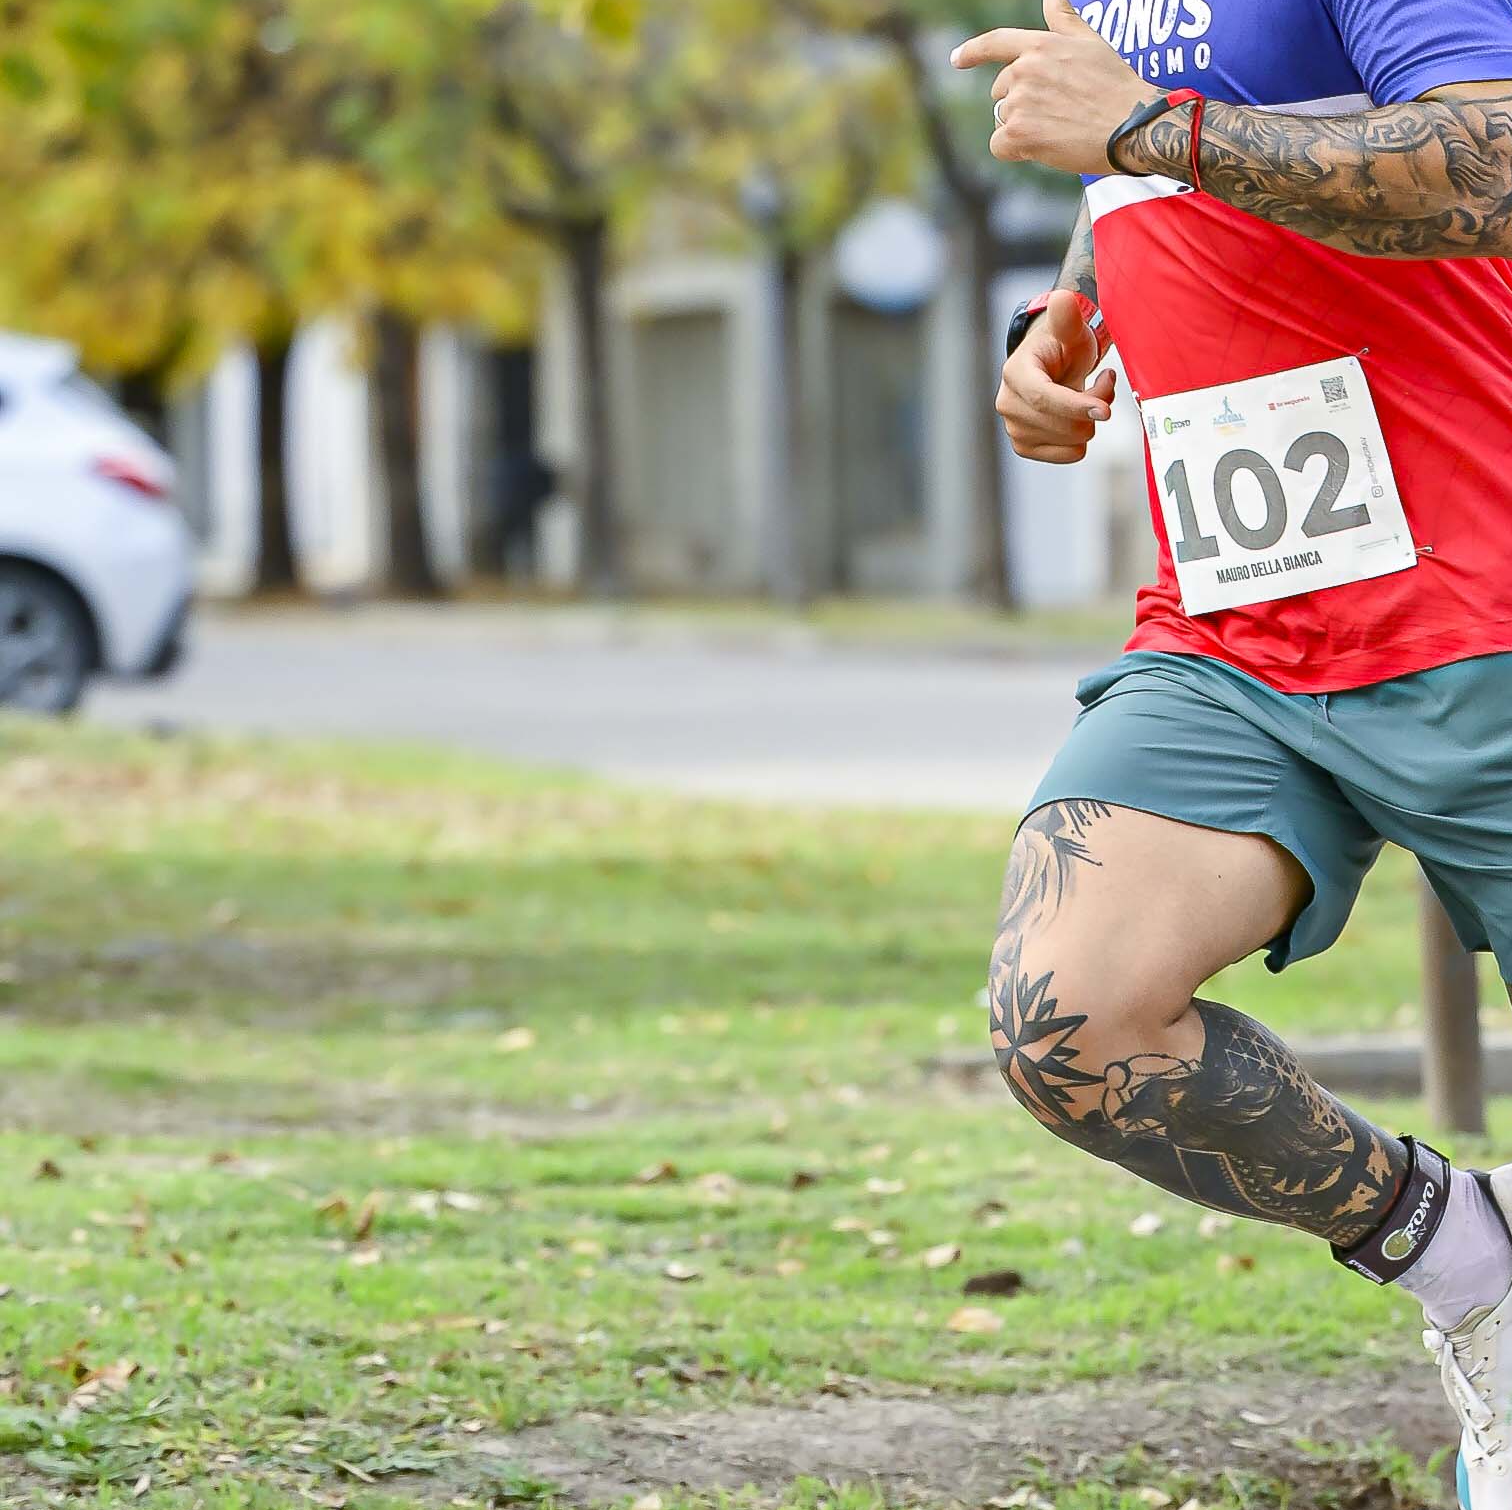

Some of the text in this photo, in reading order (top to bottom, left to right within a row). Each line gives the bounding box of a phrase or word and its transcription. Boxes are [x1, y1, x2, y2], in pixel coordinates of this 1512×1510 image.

[1122, 42, 1211, 79] ISMO
[1164, 431, 1371, 563] 102
[1216, 550, 1324, 585] MAURO DELLA BIANCA
